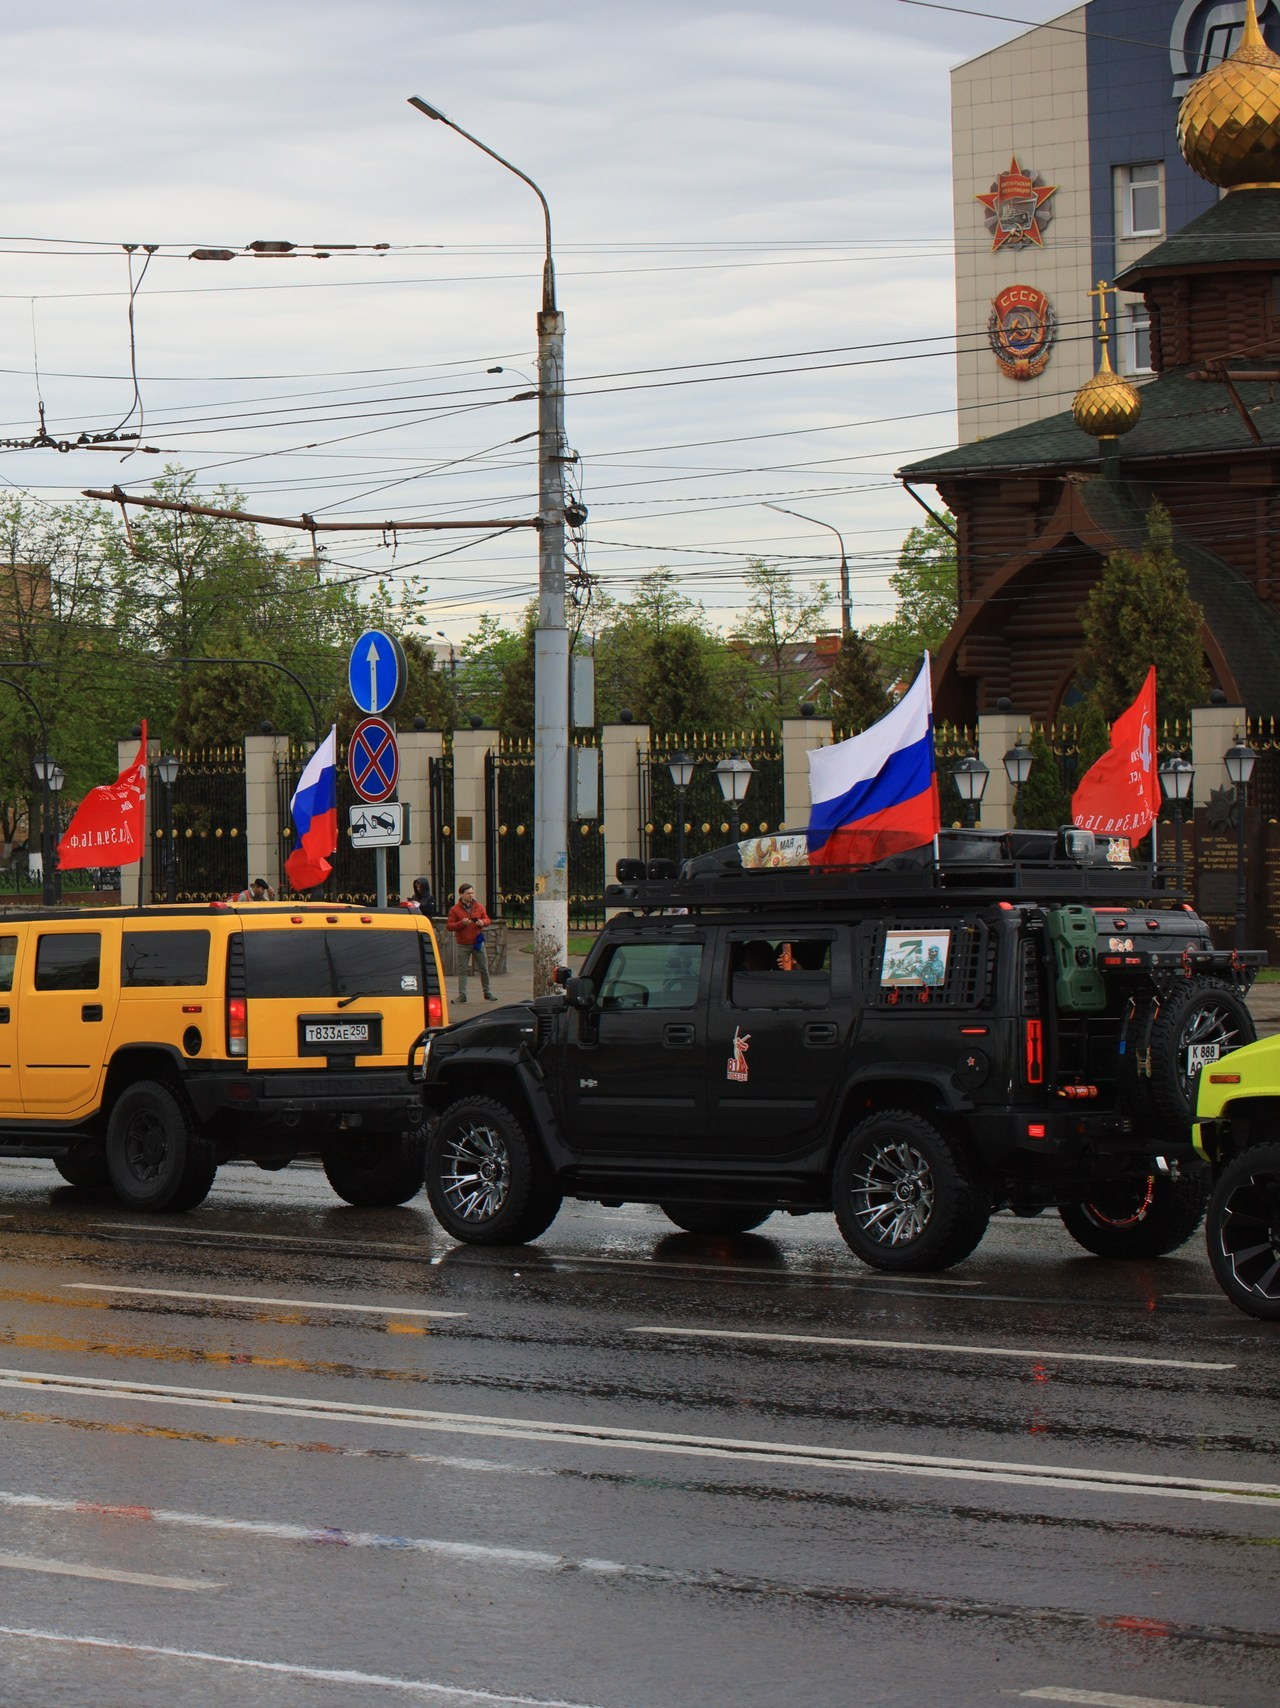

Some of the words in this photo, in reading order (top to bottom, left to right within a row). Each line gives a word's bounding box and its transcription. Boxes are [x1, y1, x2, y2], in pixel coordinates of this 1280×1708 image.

[1001, 290, 1038, 306] СССР
[309, 1027, 349, 1040] Т833АЕ
[350, 1026, 366, 1036] 250
[1193, 1046, 1198, 1058] К
[1200, 1046, 1215, 1058] 888
